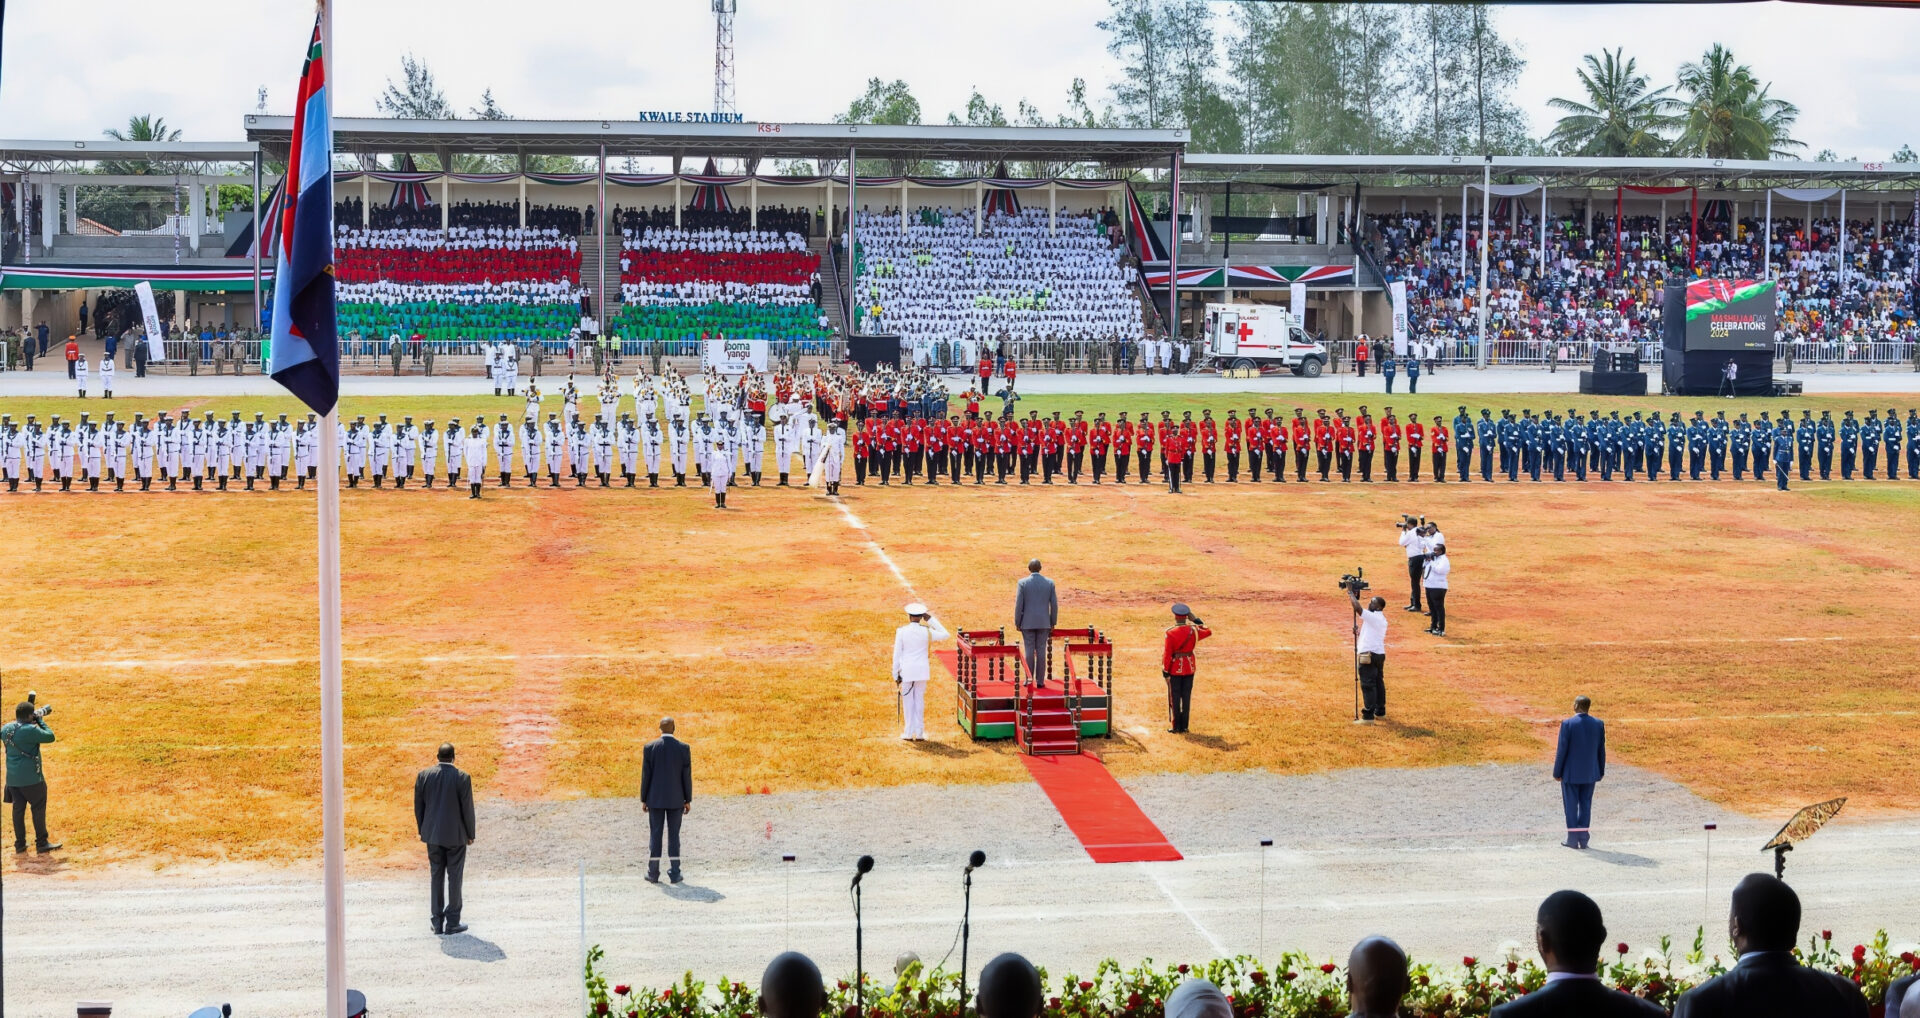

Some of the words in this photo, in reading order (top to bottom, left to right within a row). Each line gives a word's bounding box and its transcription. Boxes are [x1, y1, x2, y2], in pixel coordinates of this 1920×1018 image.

[639, 111, 682, 123] KWALE
[686, 112, 743, 123] STADIUM
[757, 124, 781, 133] KS-6
[1863, 163, 1883, 171] KS-5
[1710, 321, 1766, 331] CELEBRATIONS
[1710, 329, 1729, 338] 2024
[725, 341, 750, 350] boma
[727, 351, 750, 360] yangu
